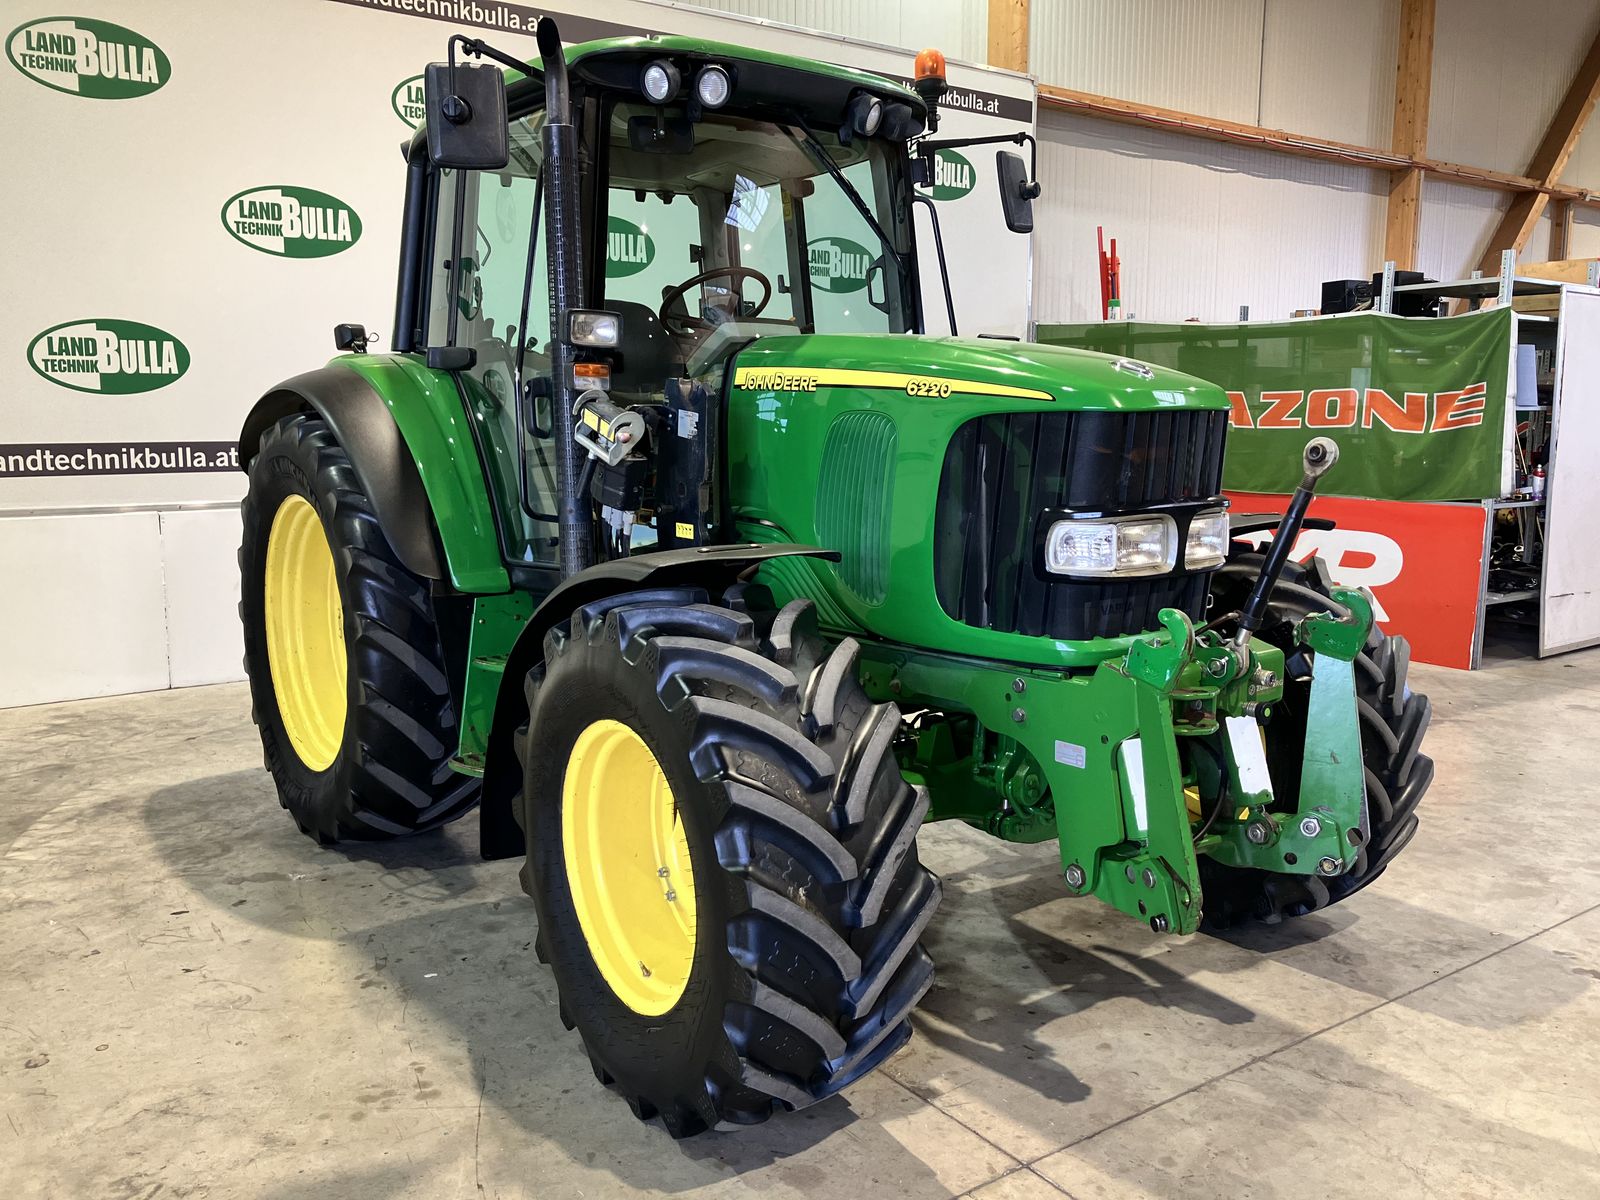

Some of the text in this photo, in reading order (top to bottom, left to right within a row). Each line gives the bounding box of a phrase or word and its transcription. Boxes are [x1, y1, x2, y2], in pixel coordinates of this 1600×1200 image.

[355, 0, 543, 31] echnikbulla.a
[25, 30, 76, 56] LAND
[20, 53, 78, 73] TECHNIK
[75, 28, 159, 84] BULLA
[935, 154, 970, 189] BULLA
[239, 200, 282, 221] LAND
[281, 196, 352, 242] BULLA
[234, 221, 284, 237] TECHNIK
[606, 232, 648, 263] ULLA
[808, 249, 830, 265] AND
[809, 265, 830, 277] CHNIK
[830, 245, 870, 279] BULLA
[47, 336, 97, 357] LAND
[96, 330, 179, 374] BULLA
[42, 359, 99, 373] TECHNIK
[906, 379, 952, 398] 6220
